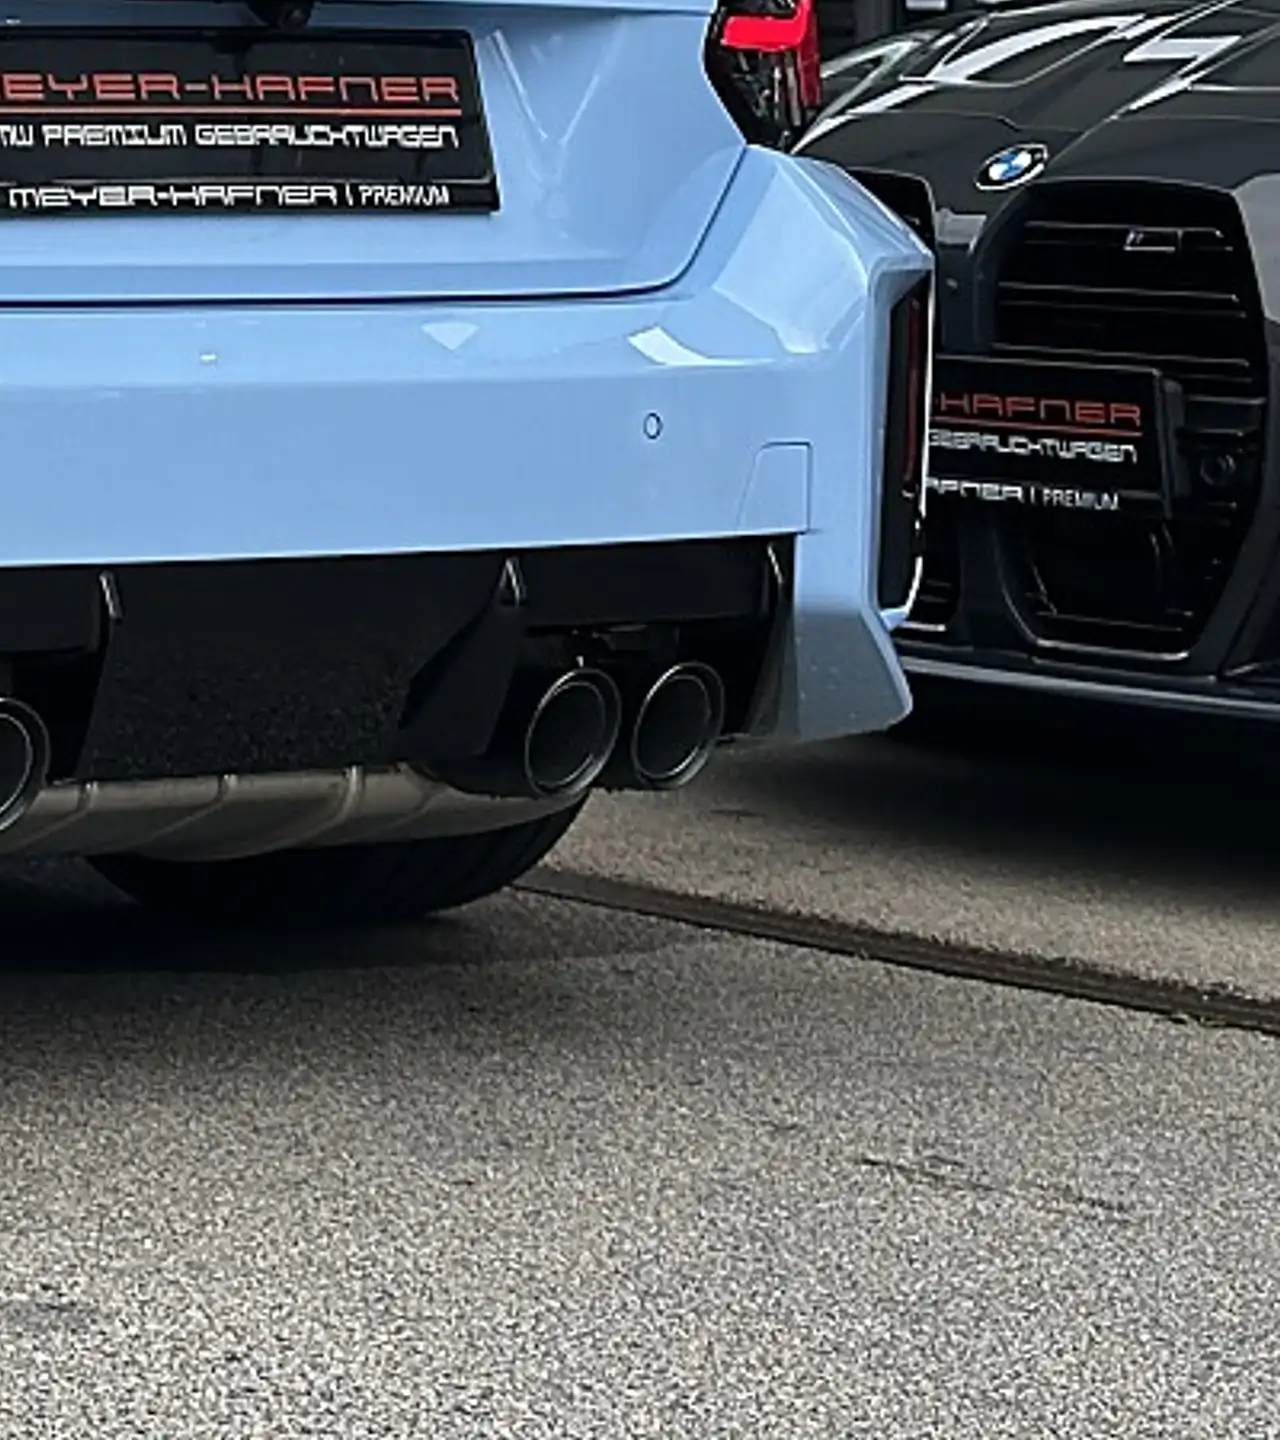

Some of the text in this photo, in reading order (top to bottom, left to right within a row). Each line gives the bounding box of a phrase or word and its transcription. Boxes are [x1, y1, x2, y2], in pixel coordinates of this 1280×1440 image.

[42, 124, 188, 146] PREMIUM
[195, 124, 460, 148] GEBRAUCHTWAGEN
[9, 185, 450, 207] MEYER-HAFNER PREMIUM
[1043, 488, 1119, 511] PREMIUM
